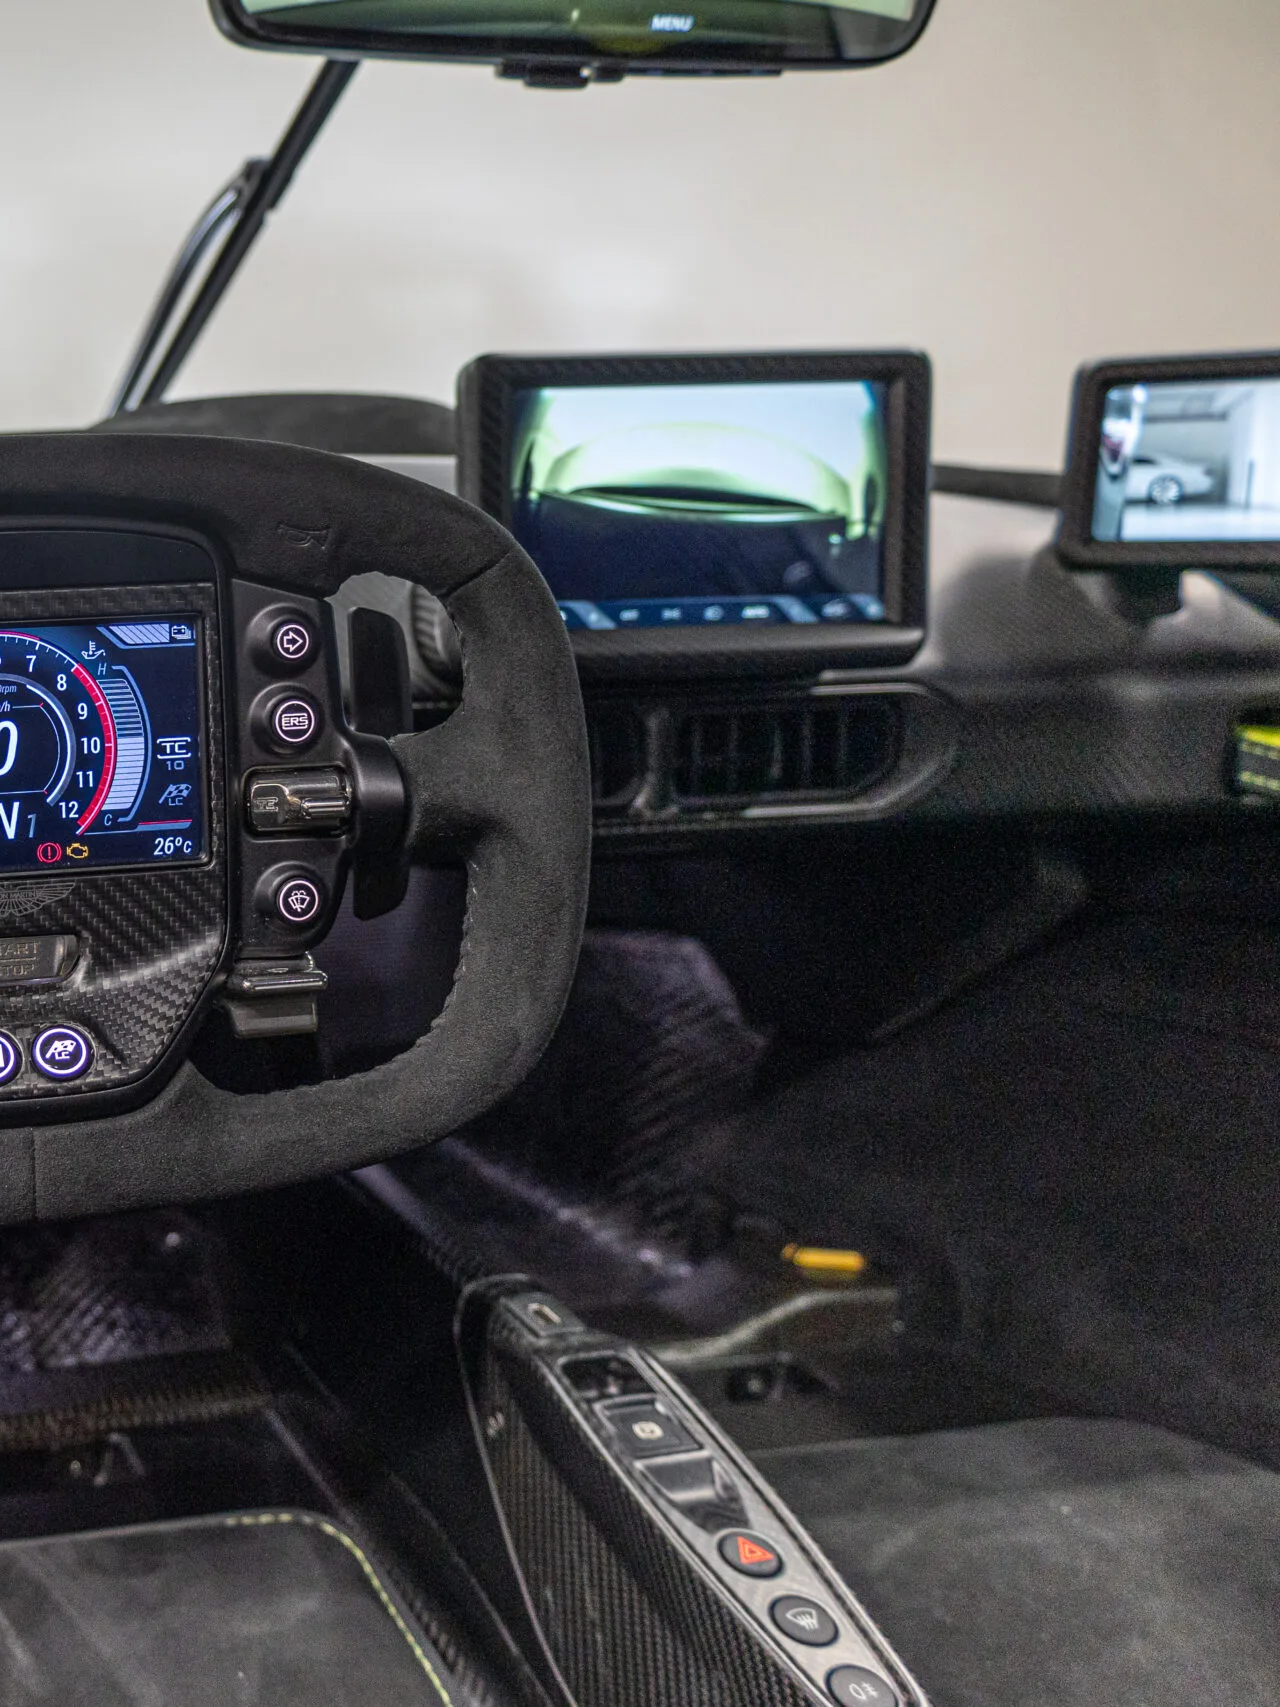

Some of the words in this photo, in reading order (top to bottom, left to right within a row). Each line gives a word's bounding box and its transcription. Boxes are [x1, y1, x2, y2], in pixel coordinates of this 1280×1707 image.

[652, 14, 694, 32] MENU
[26, 655, 37, 673] 7
[97, 663, 107, 676] H
[56, 674, 67, 691] 8
[77, 703, 88, 720] 9
[282, 716, 308, 726] ERS
[81, 737, 101, 754] 10
[161, 741, 187, 754] TC
[166, 760, 185, 771] 10
[76, 771, 94, 788] 11
[59, 801, 79, 818] 12
[168, 797, 184, 806] LC
[27, 814, 37, 838] 1
[104, 814, 113, 826] C
[55, 1051, 70, 1060] LC
